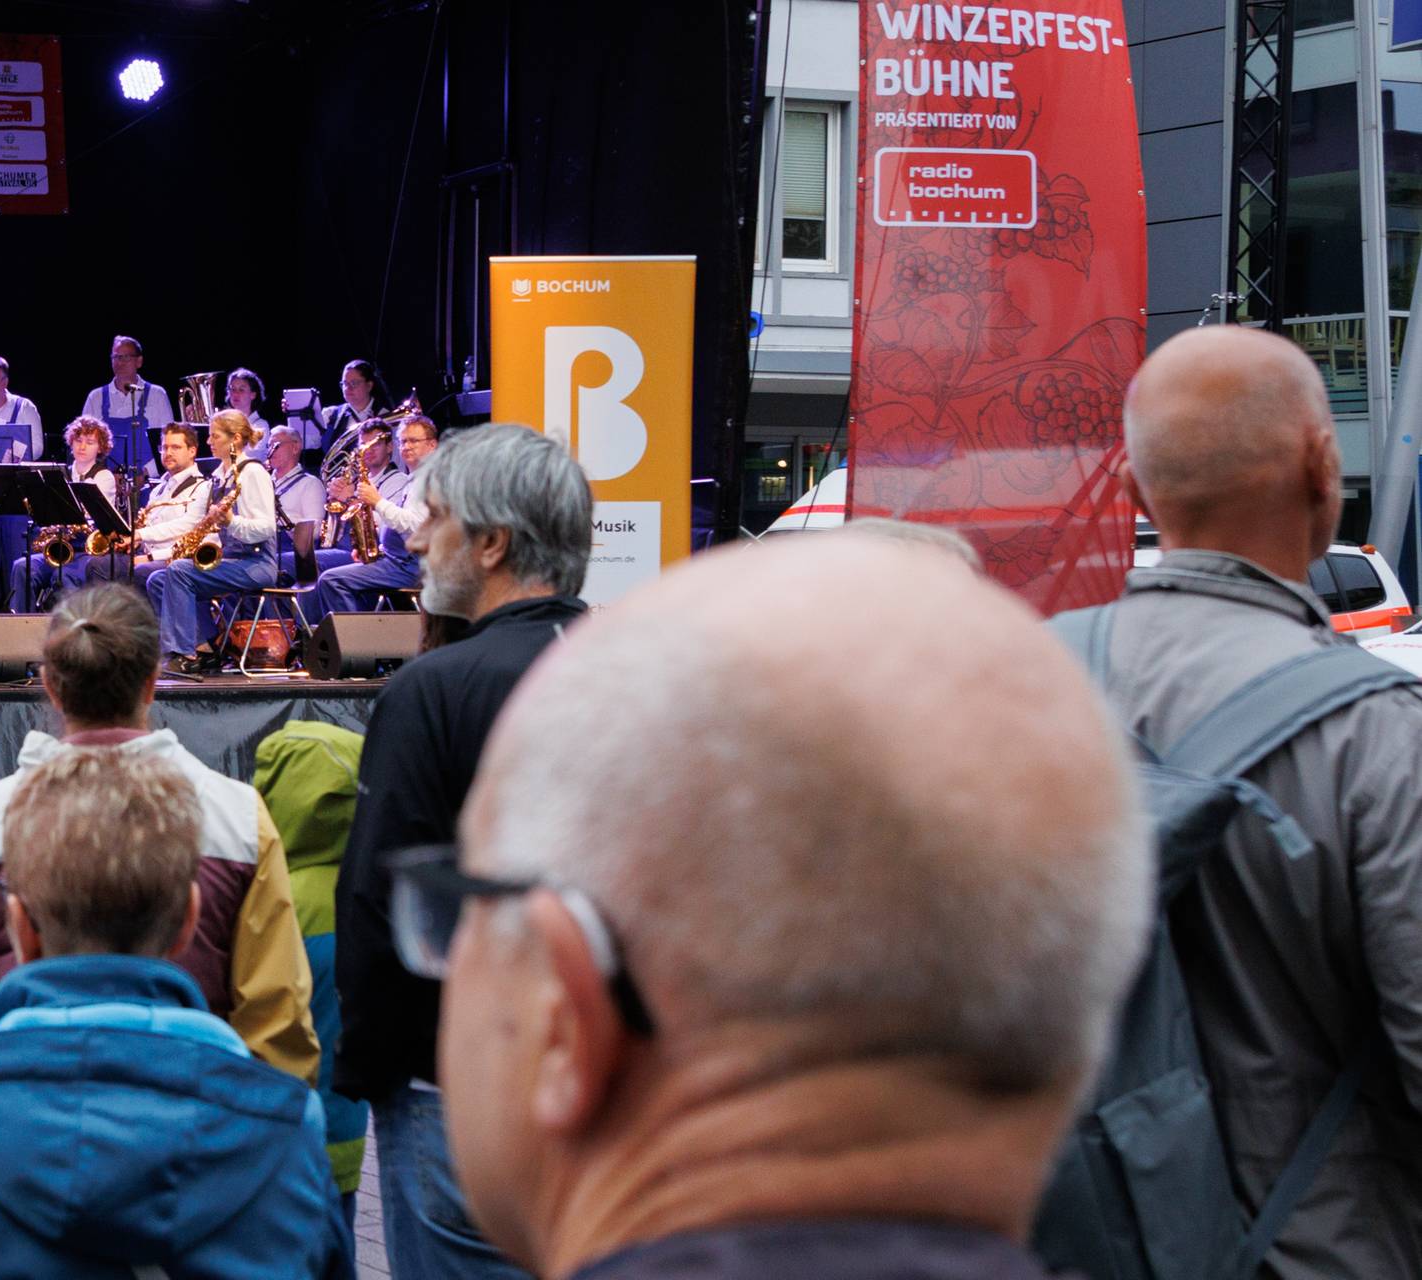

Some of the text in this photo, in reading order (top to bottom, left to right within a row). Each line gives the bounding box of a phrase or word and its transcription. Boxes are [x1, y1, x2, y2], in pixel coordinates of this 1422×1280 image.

[877, 3, 1124, 54] WINZERFEST-
[875, 49, 1016, 100] BÜHNE
[874, 108, 1017, 130] PRÄSENTIERT VON
[909, 163, 973, 179] radio
[909, 183, 1006, 200] bochum
[536, 280, 610, 294] BOCHUM
[591, 520, 636, 533] Musik
